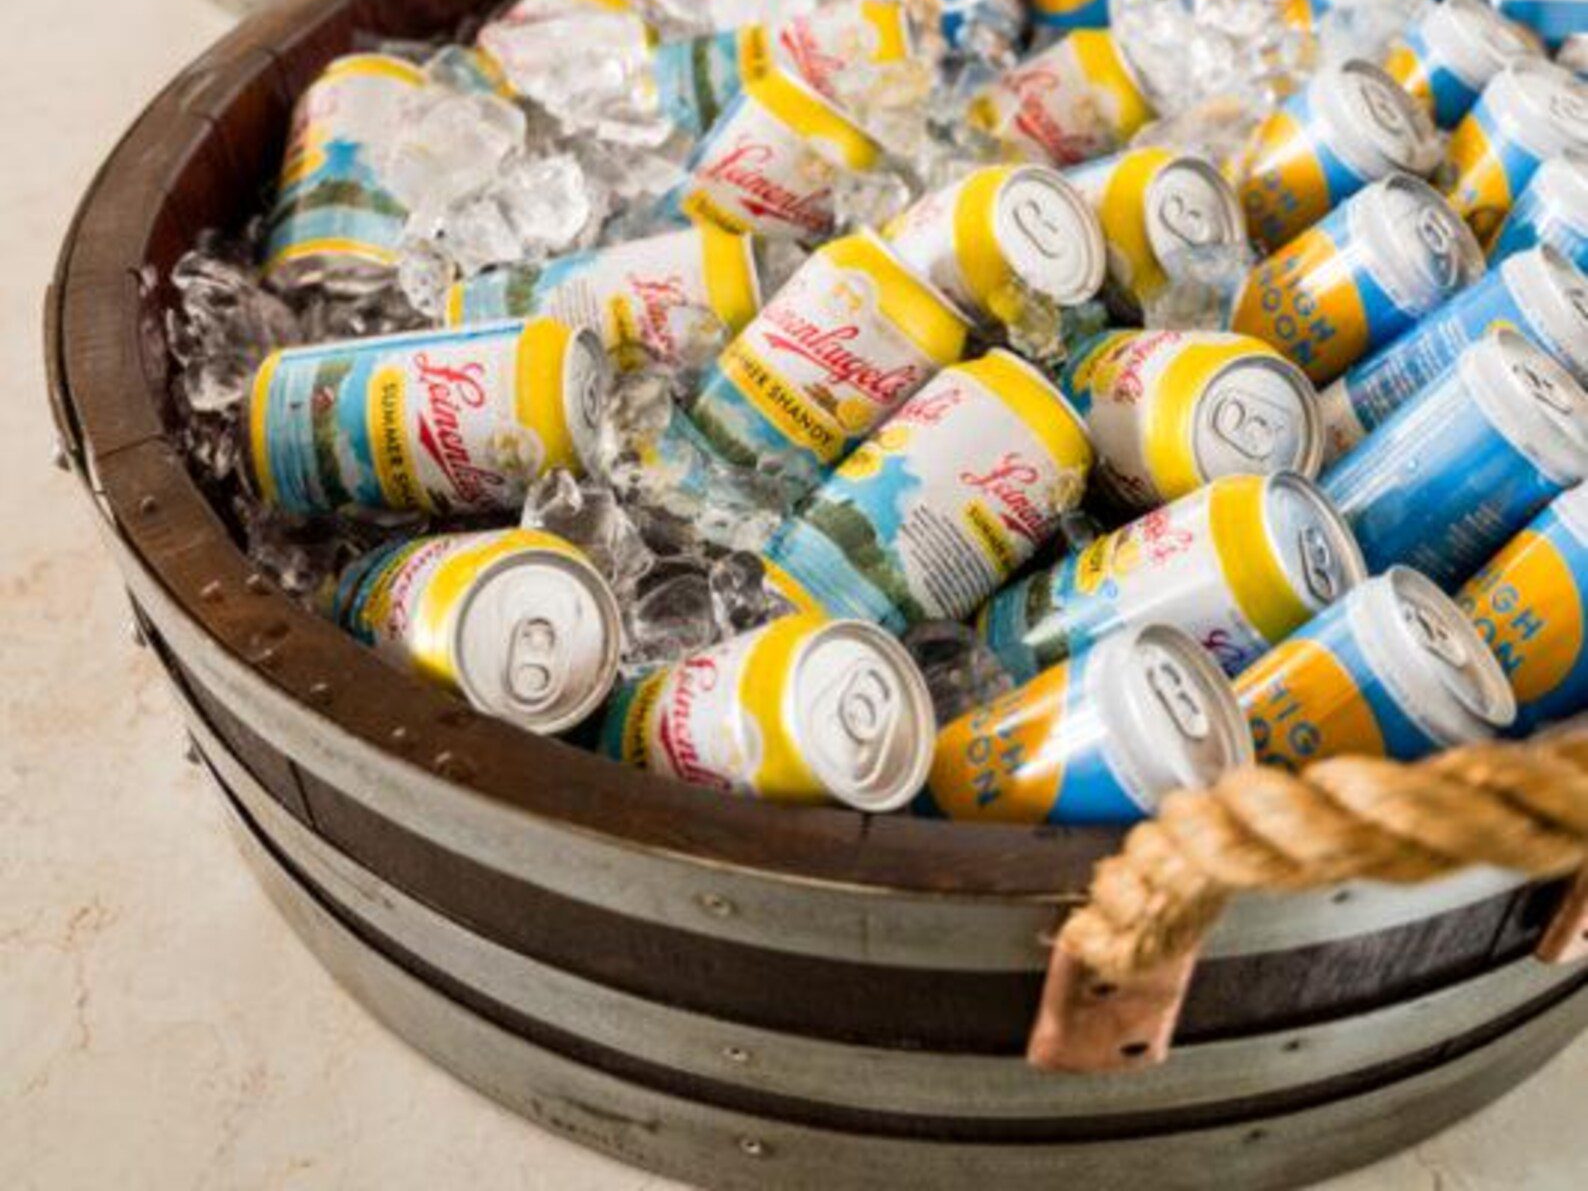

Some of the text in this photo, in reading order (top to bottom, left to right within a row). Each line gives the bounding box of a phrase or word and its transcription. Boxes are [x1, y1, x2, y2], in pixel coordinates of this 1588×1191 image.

[380, 380, 417, 506] SUMMER SHA
[767, 384, 836, 447] SHANDY
[1265, 678, 1323, 758] HIG
